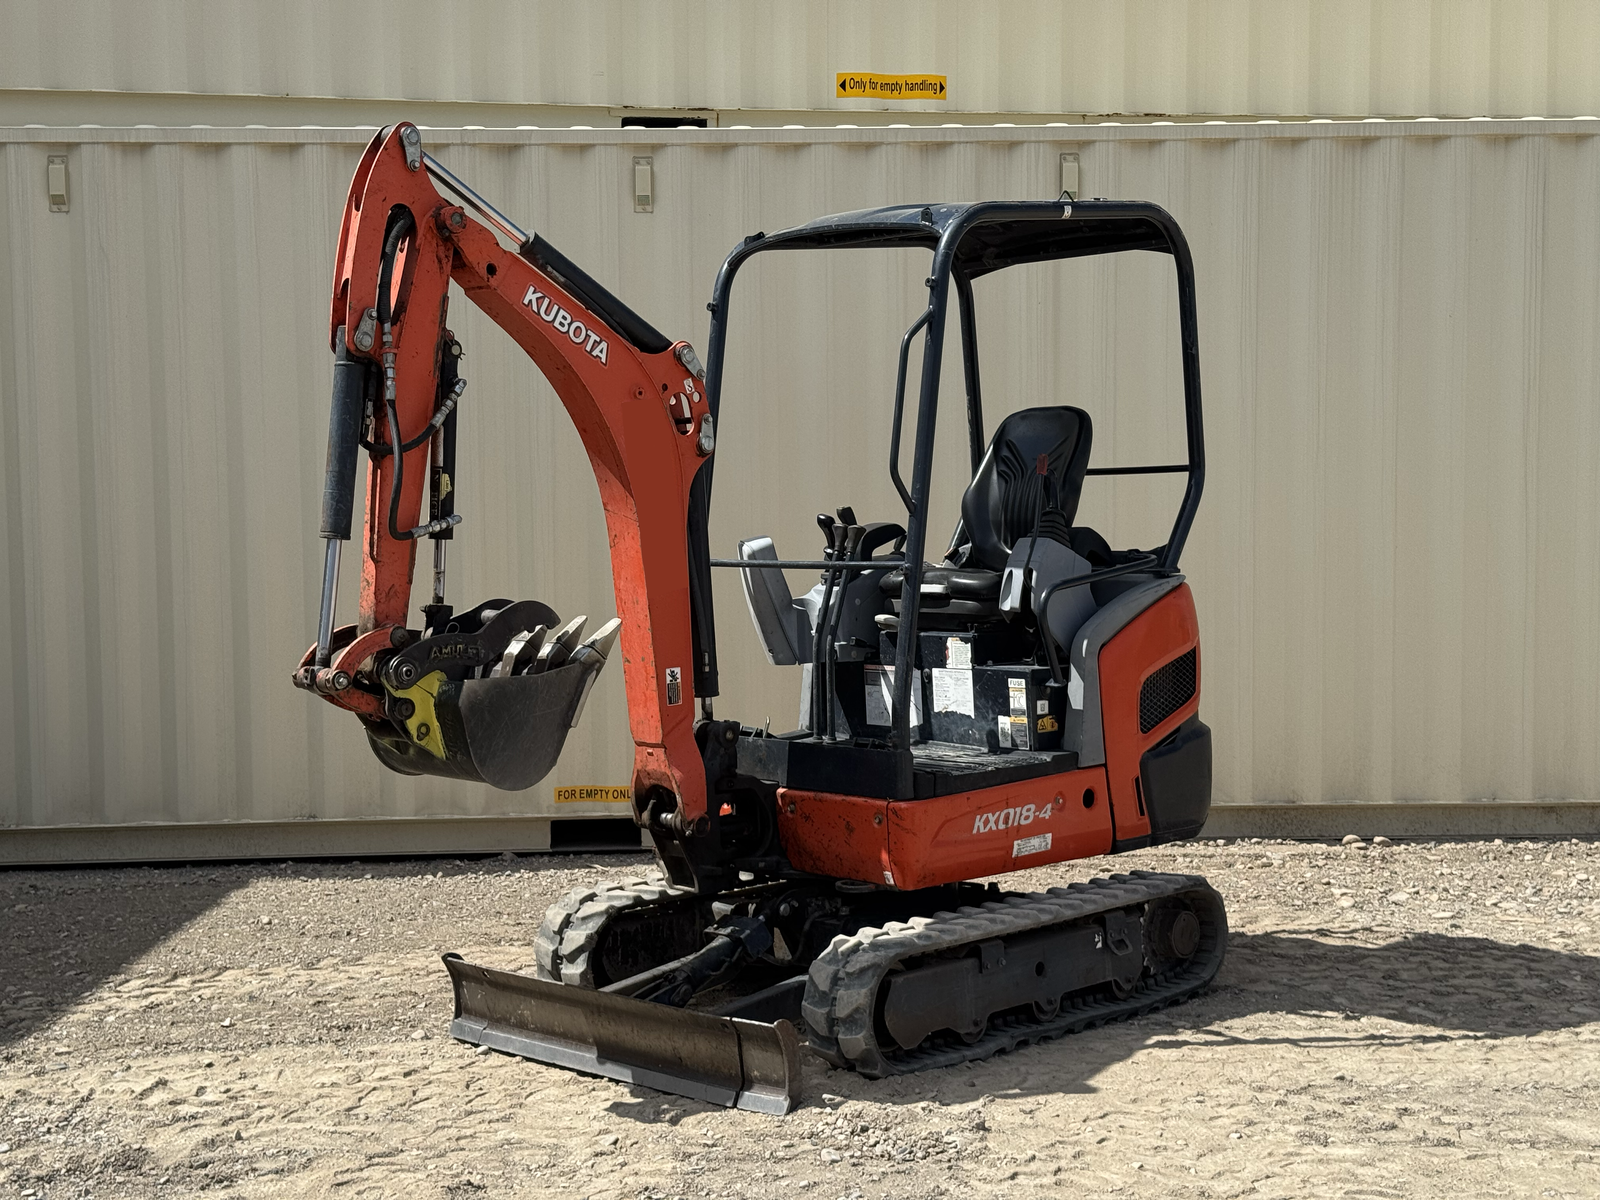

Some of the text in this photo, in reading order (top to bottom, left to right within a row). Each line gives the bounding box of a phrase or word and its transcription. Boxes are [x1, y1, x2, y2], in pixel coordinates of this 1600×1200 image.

[849, 77, 938, 95] Only for empty handling
[522, 285, 609, 366] KUBOTA
[558, 788, 631, 800] FOR EMPTY ONL
[972, 802, 1052, 834] KX018-4
